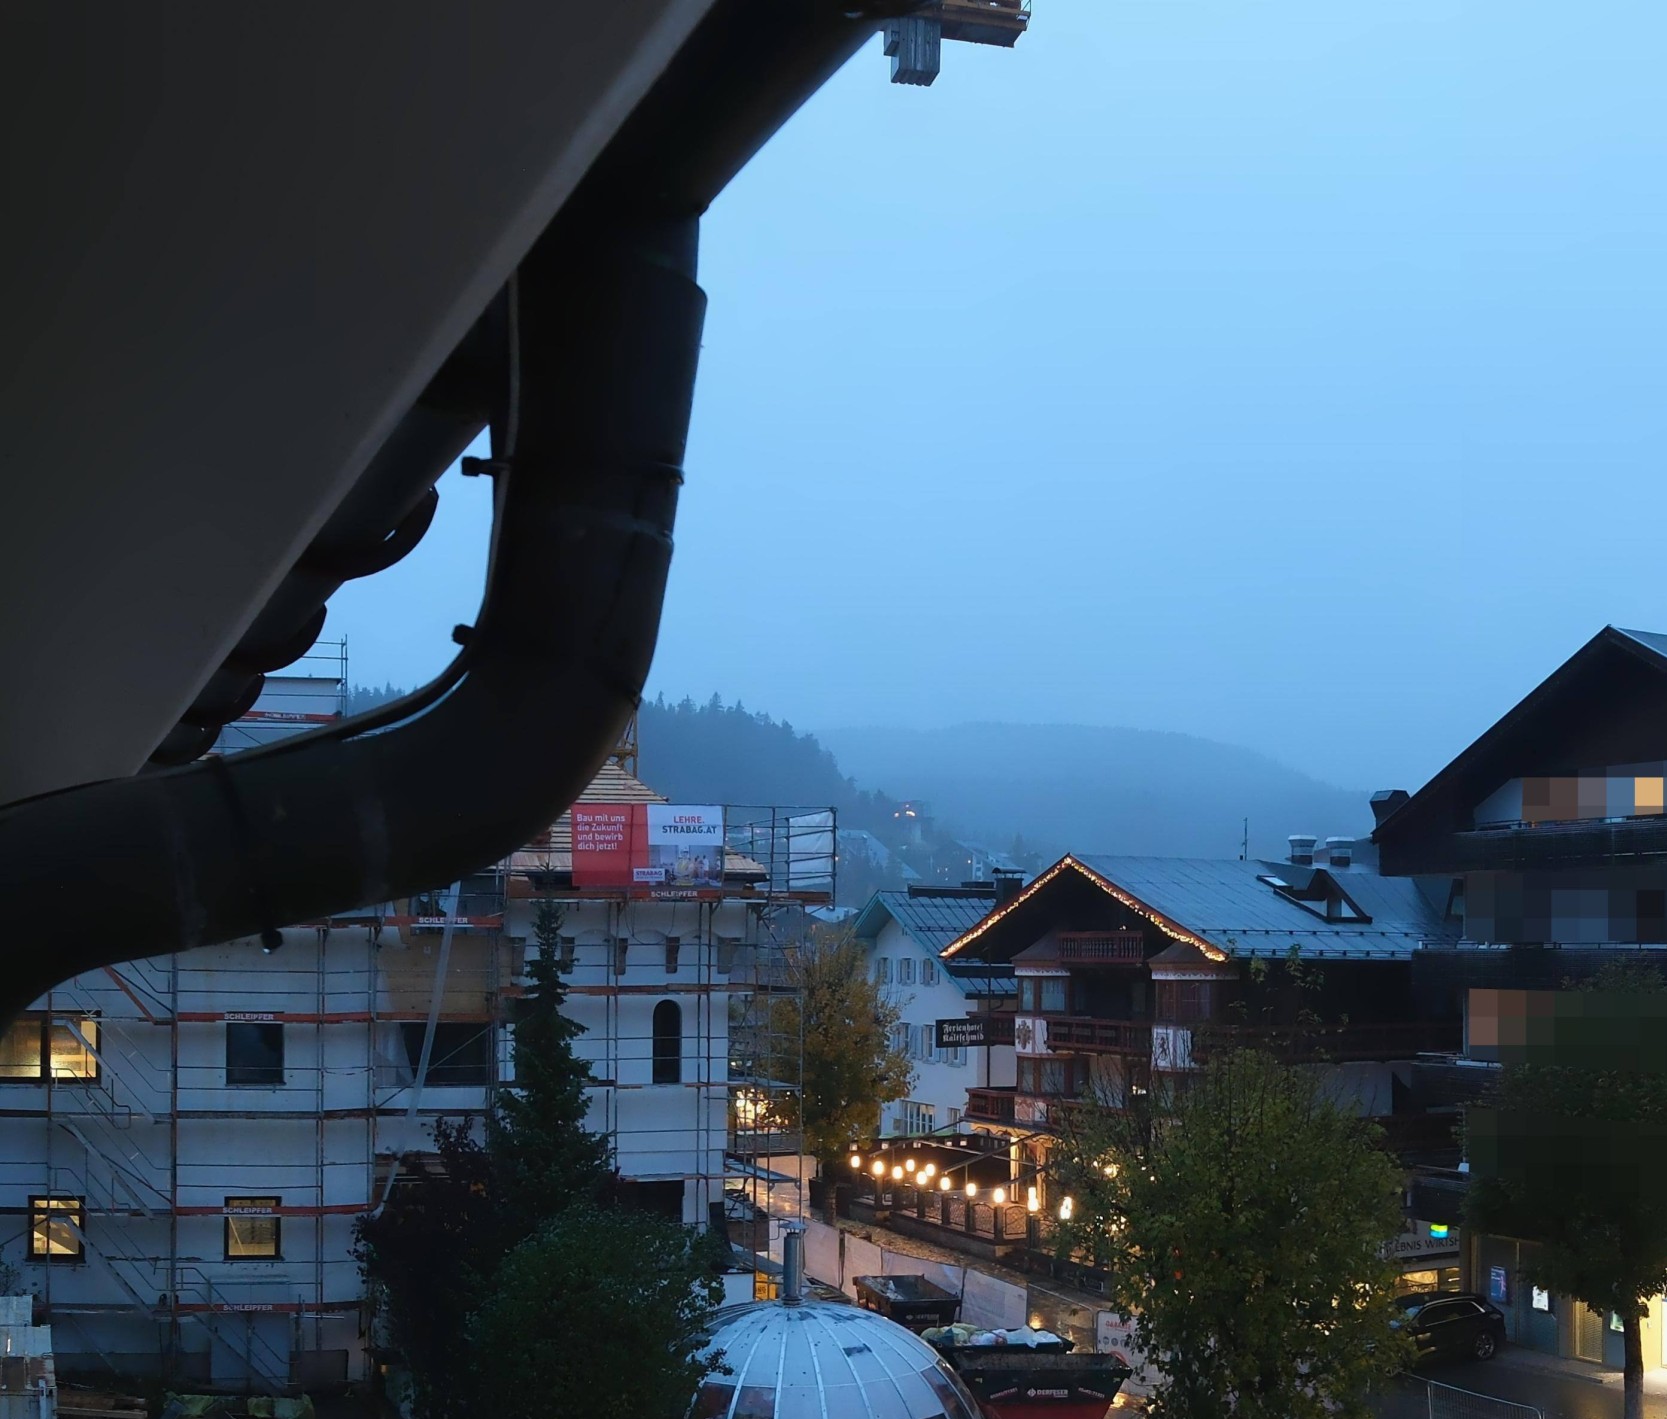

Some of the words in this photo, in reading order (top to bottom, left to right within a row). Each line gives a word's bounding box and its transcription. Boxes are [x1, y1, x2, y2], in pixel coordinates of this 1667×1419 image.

[576, 814, 592, 822] Bau
[594, 814, 608, 822] mit
[673, 815, 705, 824] LEHRE.
[577, 823, 588, 831] die
[591, 824, 623, 832] Zukunft
[662, 825, 717, 834] STRABAG.AT
[577, 833, 593, 841] und
[595, 833, 623, 841] bewirb
[577, 842, 593, 850] dich
[595, 842, 617, 852] jetzt!
[419, 916, 468, 924] SCHLEFER
